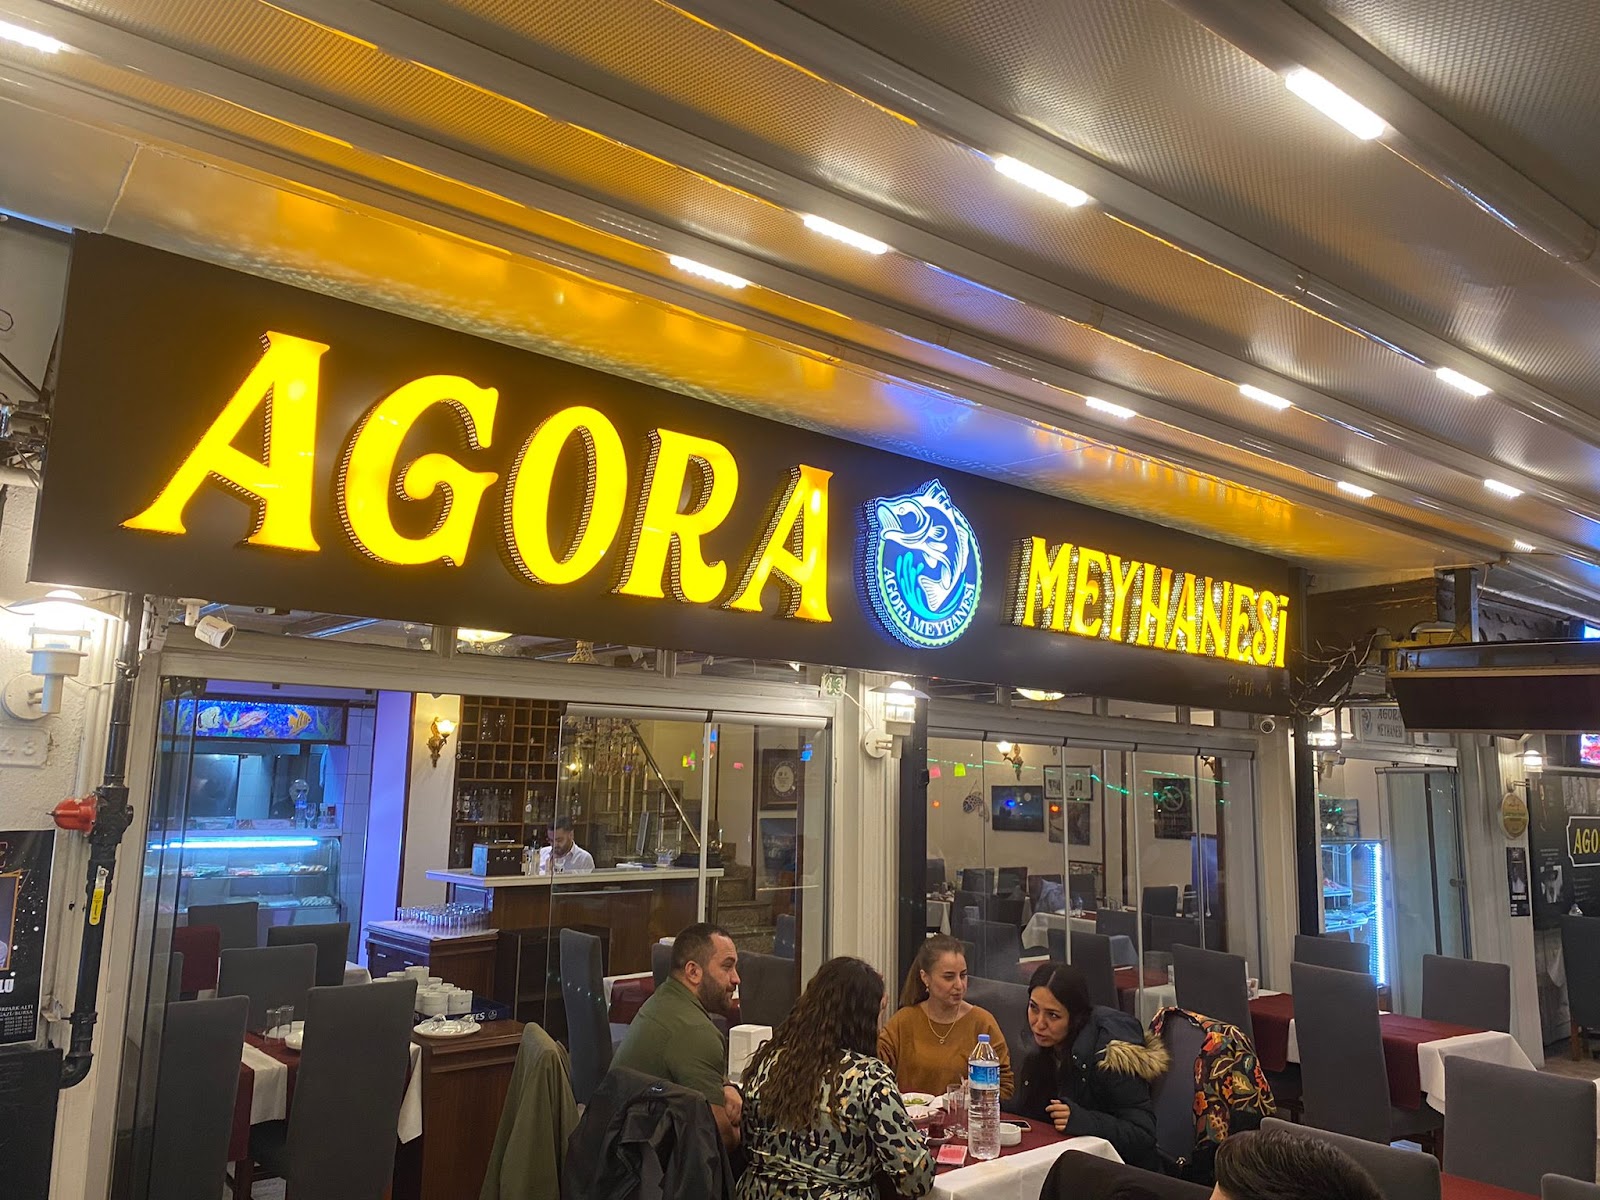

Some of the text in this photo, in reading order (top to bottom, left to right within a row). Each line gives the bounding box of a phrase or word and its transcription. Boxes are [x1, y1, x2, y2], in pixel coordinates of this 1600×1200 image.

[120, 330, 833, 623] AGORA
[883, 566, 911, 626] AGORA
[826, 677, 843, 694] 43
[1377, 709, 1402, 721] AGORA
[1573, 828, 1600, 854] AGO
